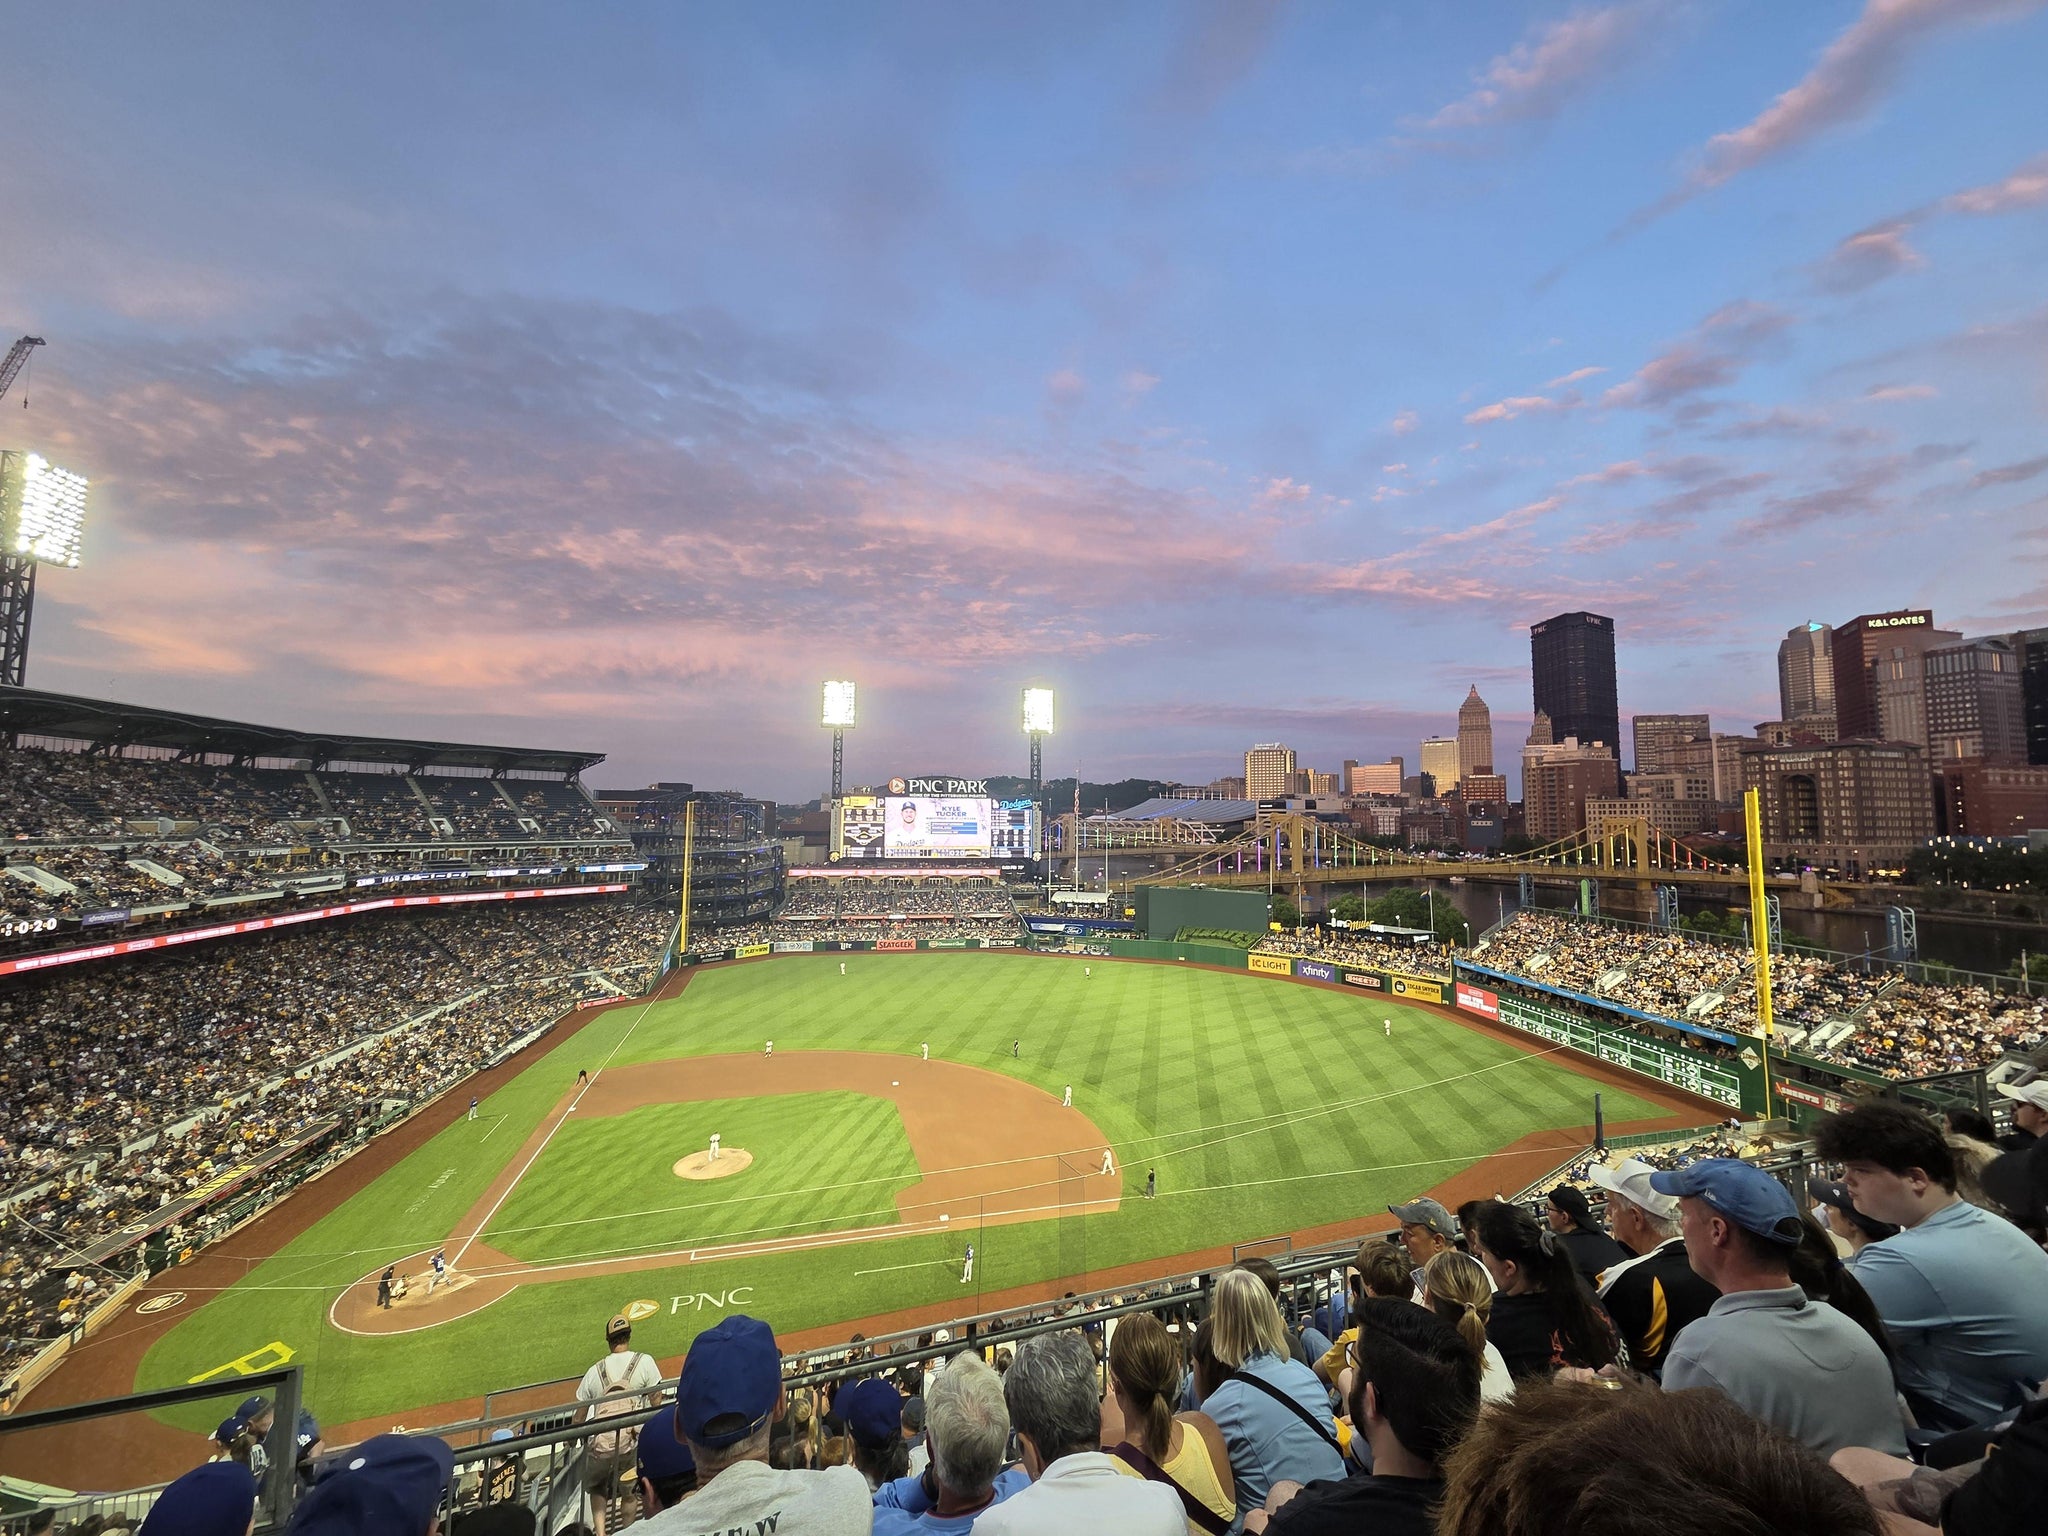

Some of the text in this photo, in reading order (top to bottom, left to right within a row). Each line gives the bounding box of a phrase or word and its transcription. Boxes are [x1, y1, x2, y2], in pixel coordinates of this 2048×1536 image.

[1868, 616, 1926, 628] K&L GATES
[908, 780, 988, 794] PNC PARK
[1000, 799, 1033, 811] Dodgers
[1064, 926, 1082, 935] Ford
[878, 941, 914, 949] SEATGEEK
[1262, 961, 1287, 971] LIGHT
[1302, 964, 1330, 980] xfinity
[1407, 983, 1422, 991] EDGAR
[1421, 986, 1440, 995] SNYDER
[670, 1286, 754, 1315] PNC
[489, 1474, 516, 1506] 30
